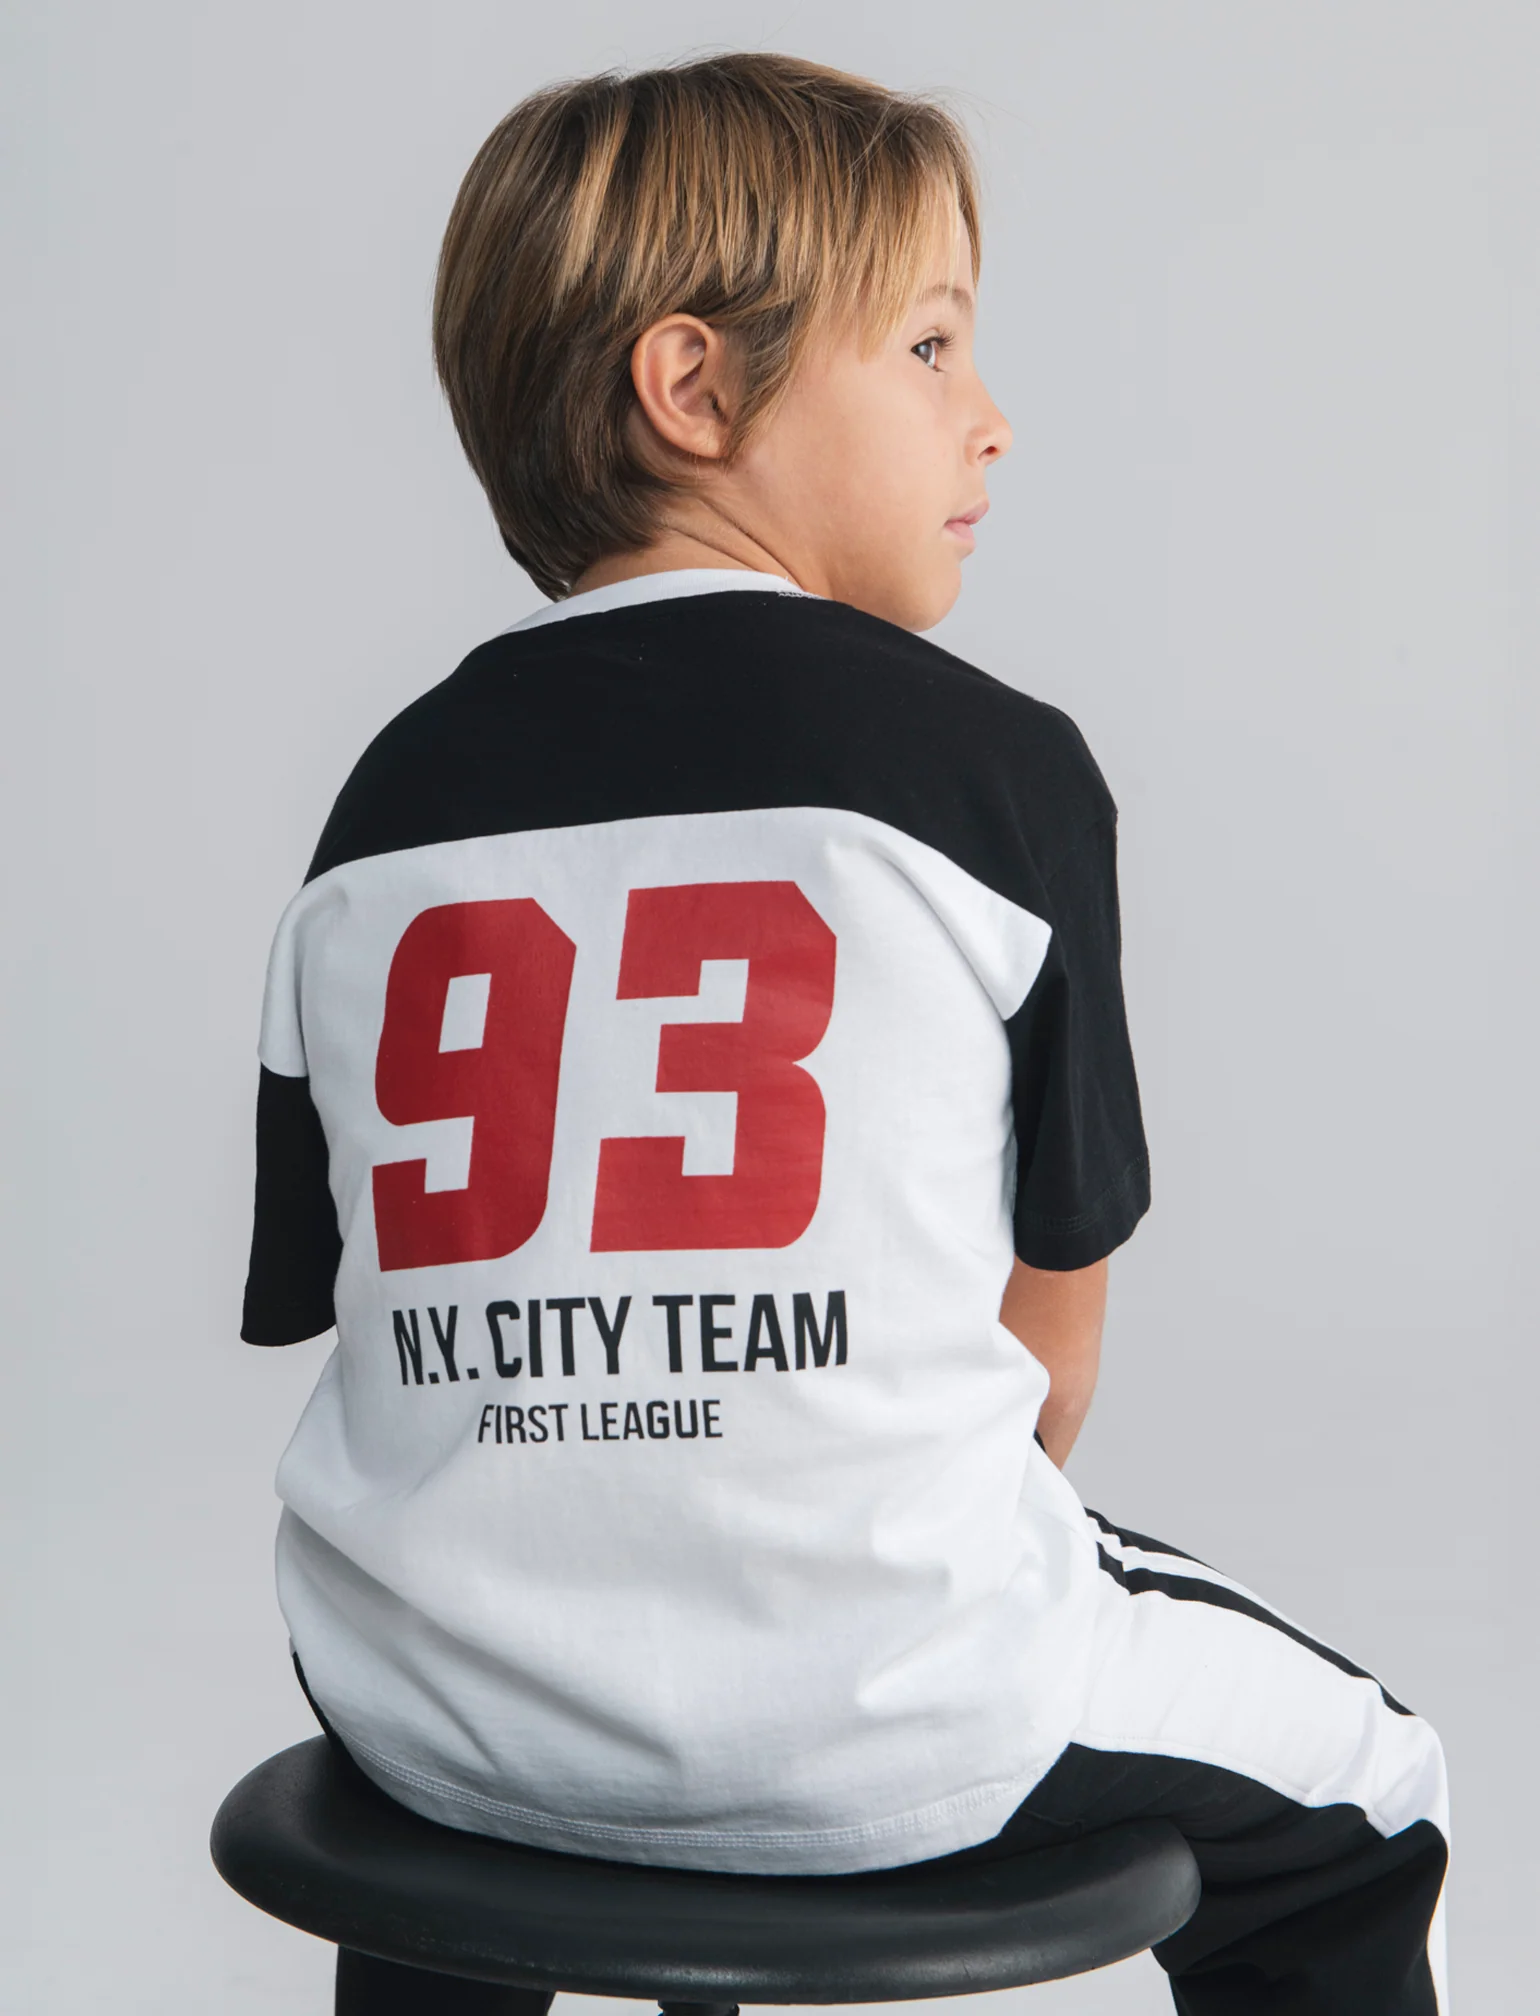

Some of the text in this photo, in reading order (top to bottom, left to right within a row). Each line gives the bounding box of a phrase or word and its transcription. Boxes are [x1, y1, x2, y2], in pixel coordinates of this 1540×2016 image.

[372, 880, 837, 1272] 93
[392, 1290, 848, 1386] N.Y. CITY TEAM
[477, 1399, 723, 1444] FIRST LEAGUE
